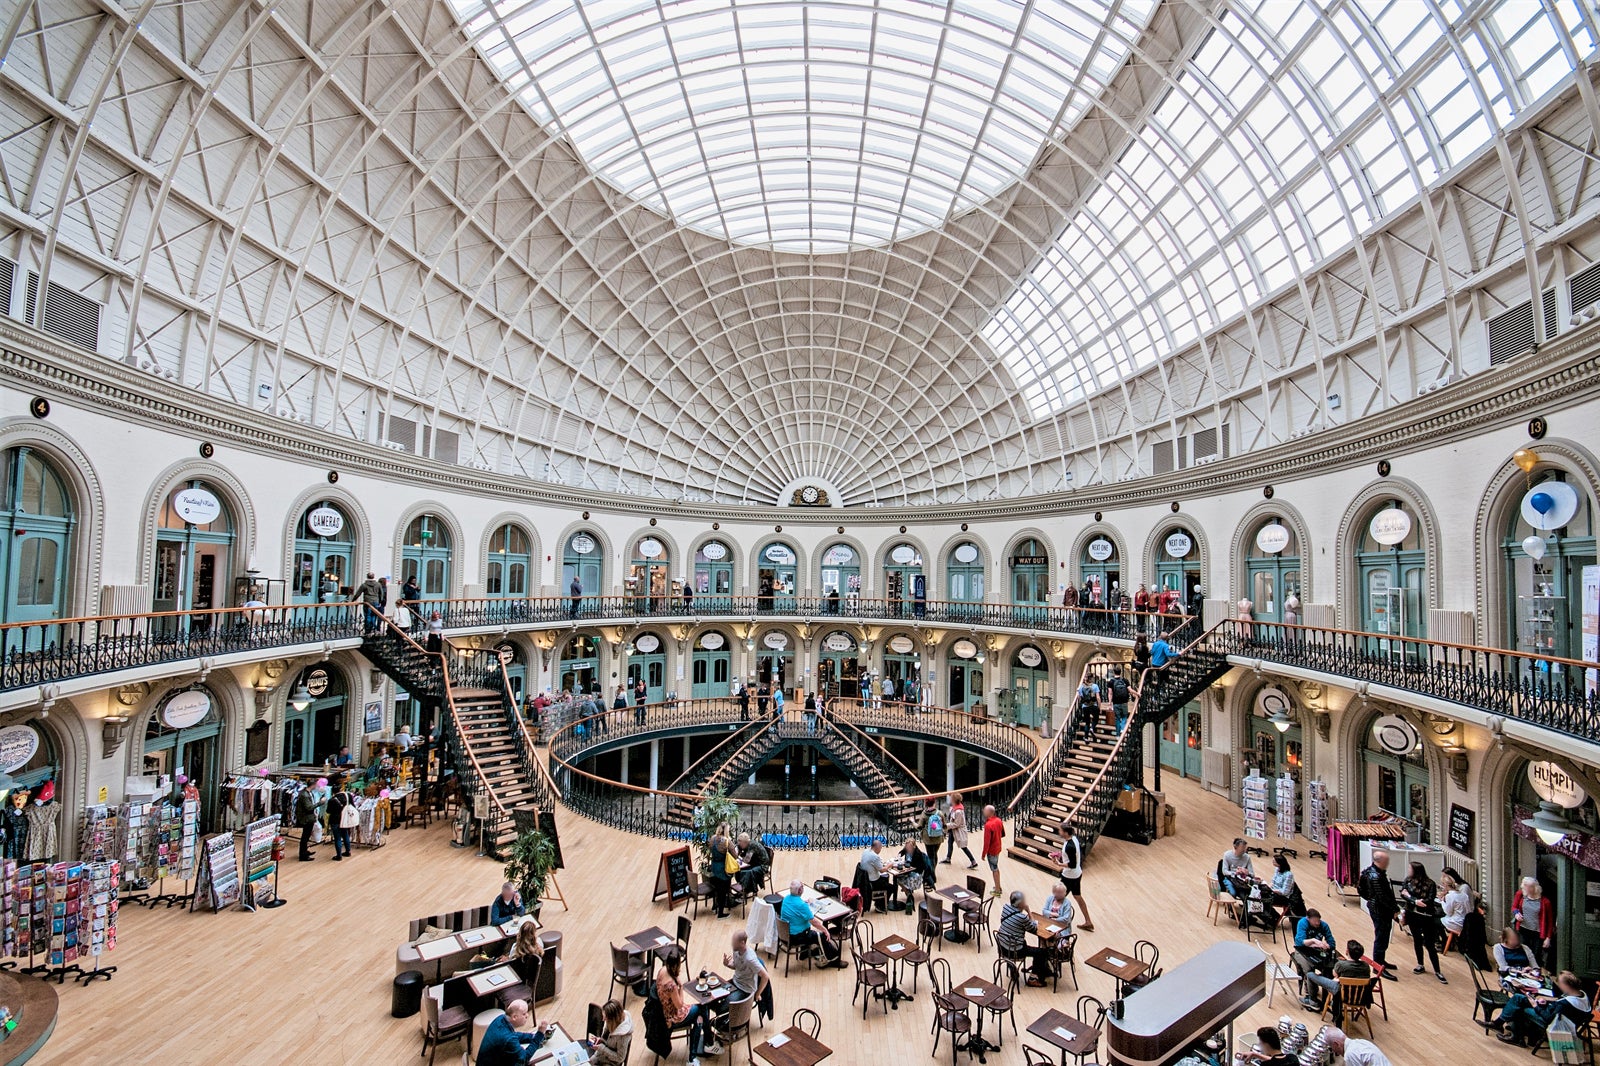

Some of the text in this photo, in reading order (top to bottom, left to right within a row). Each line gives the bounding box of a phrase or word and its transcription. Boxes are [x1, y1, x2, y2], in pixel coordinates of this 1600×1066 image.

[38, 402, 46, 412] 4
[1530, 422, 1541, 434] 13
[205, 446, 212, 454] 3
[1378, 464, 1387, 473] 14
[332, 473, 337, 481] 2
[314, 514, 340, 528] CAMERAS
[1179, 538, 1187, 546] ONE
[1534, 765, 1574, 791] HUMPIT
